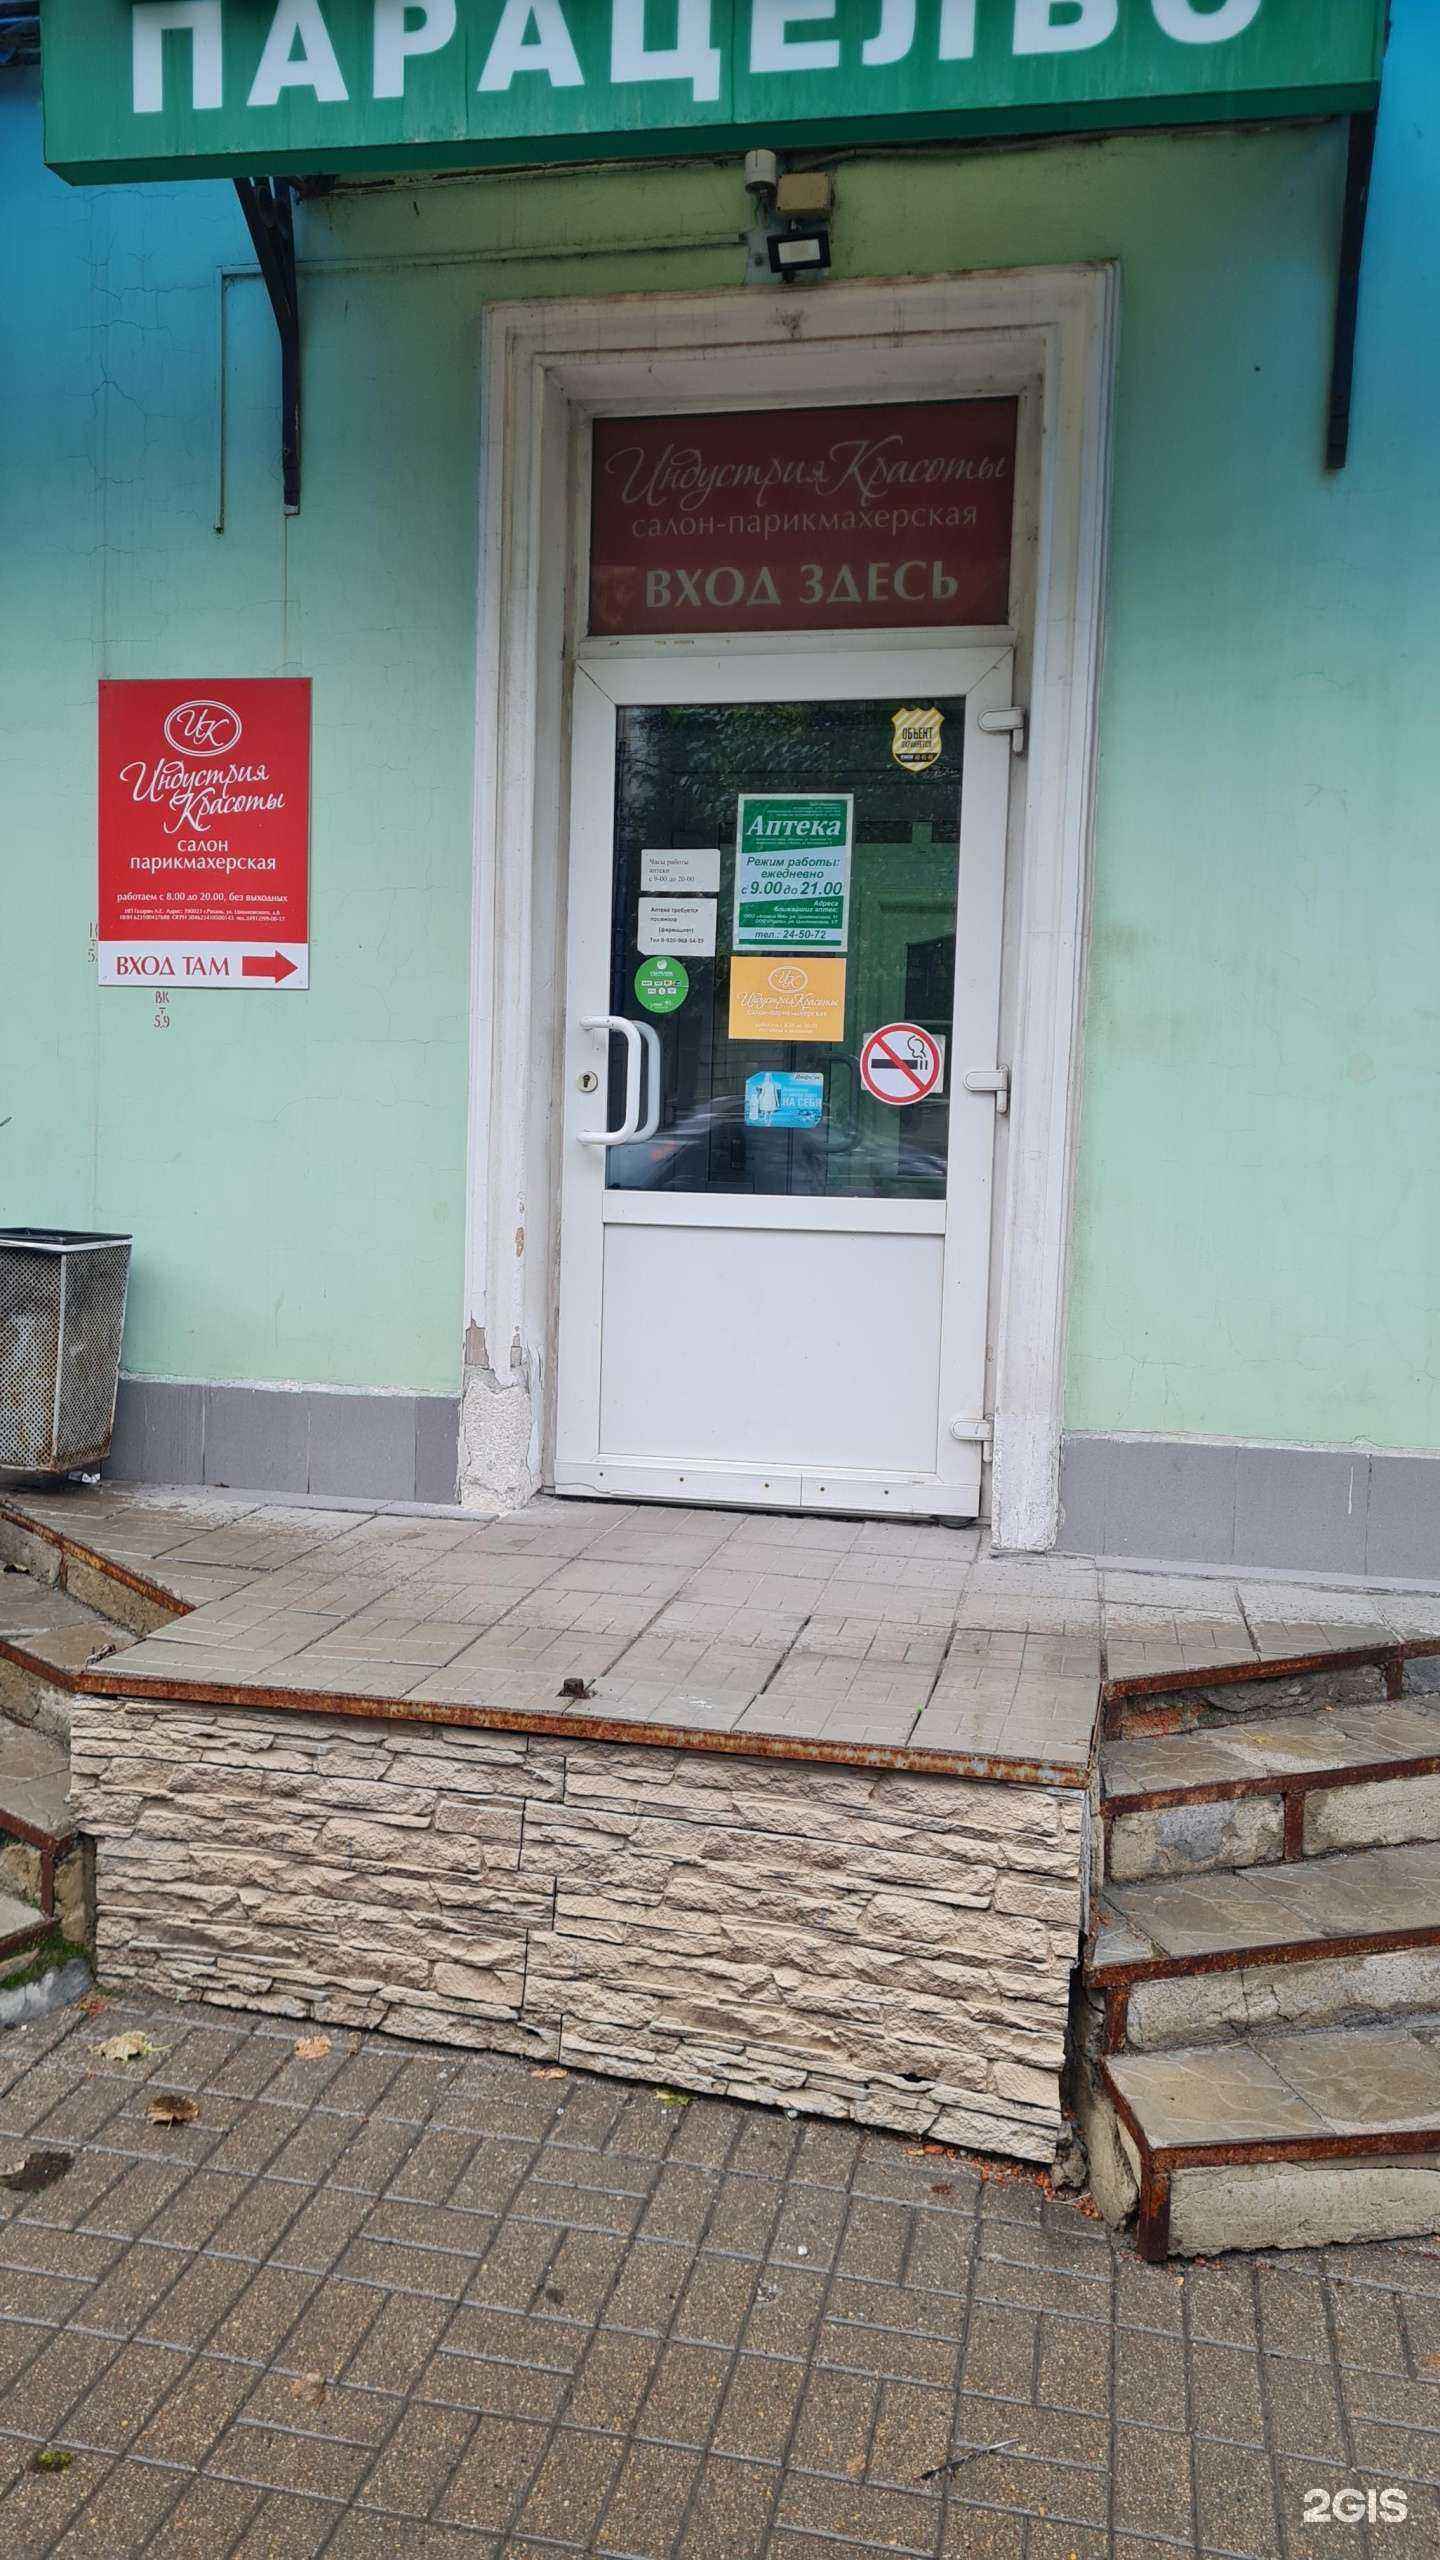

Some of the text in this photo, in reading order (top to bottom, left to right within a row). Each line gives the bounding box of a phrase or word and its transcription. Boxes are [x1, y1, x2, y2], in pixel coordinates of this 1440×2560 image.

[605, 435, 1008, 512] Индустрия Красоты
[631, 506, 978, 541] салон-парикмахерская
[645, 560, 959, 608] ВХОД ЗДЕСЬ
[119, 757, 270, 803] Индустрия
[163, 786, 286, 834] Красоты
[746, 815, 841, 836] Аптека
[177, 839, 229, 852] салон
[130, 856, 276, 875] парикмахерская
[746, 856, 841, 868] Режим работы:
[761, 868, 825, 879] ежедневно
[117, 891, 158, 904] работаем
[158, 893, 165, 901] с
[166, 892, 186, 901] 8.00
[228, 891, 244, 902] без
[245, 894, 288, 903] выходных
[741, 881, 843, 895] с 9.00 до 21.00
[783, 929, 827, 939] 24-50-72
[116, 955, 230, 976] ВХОД ТАМ
